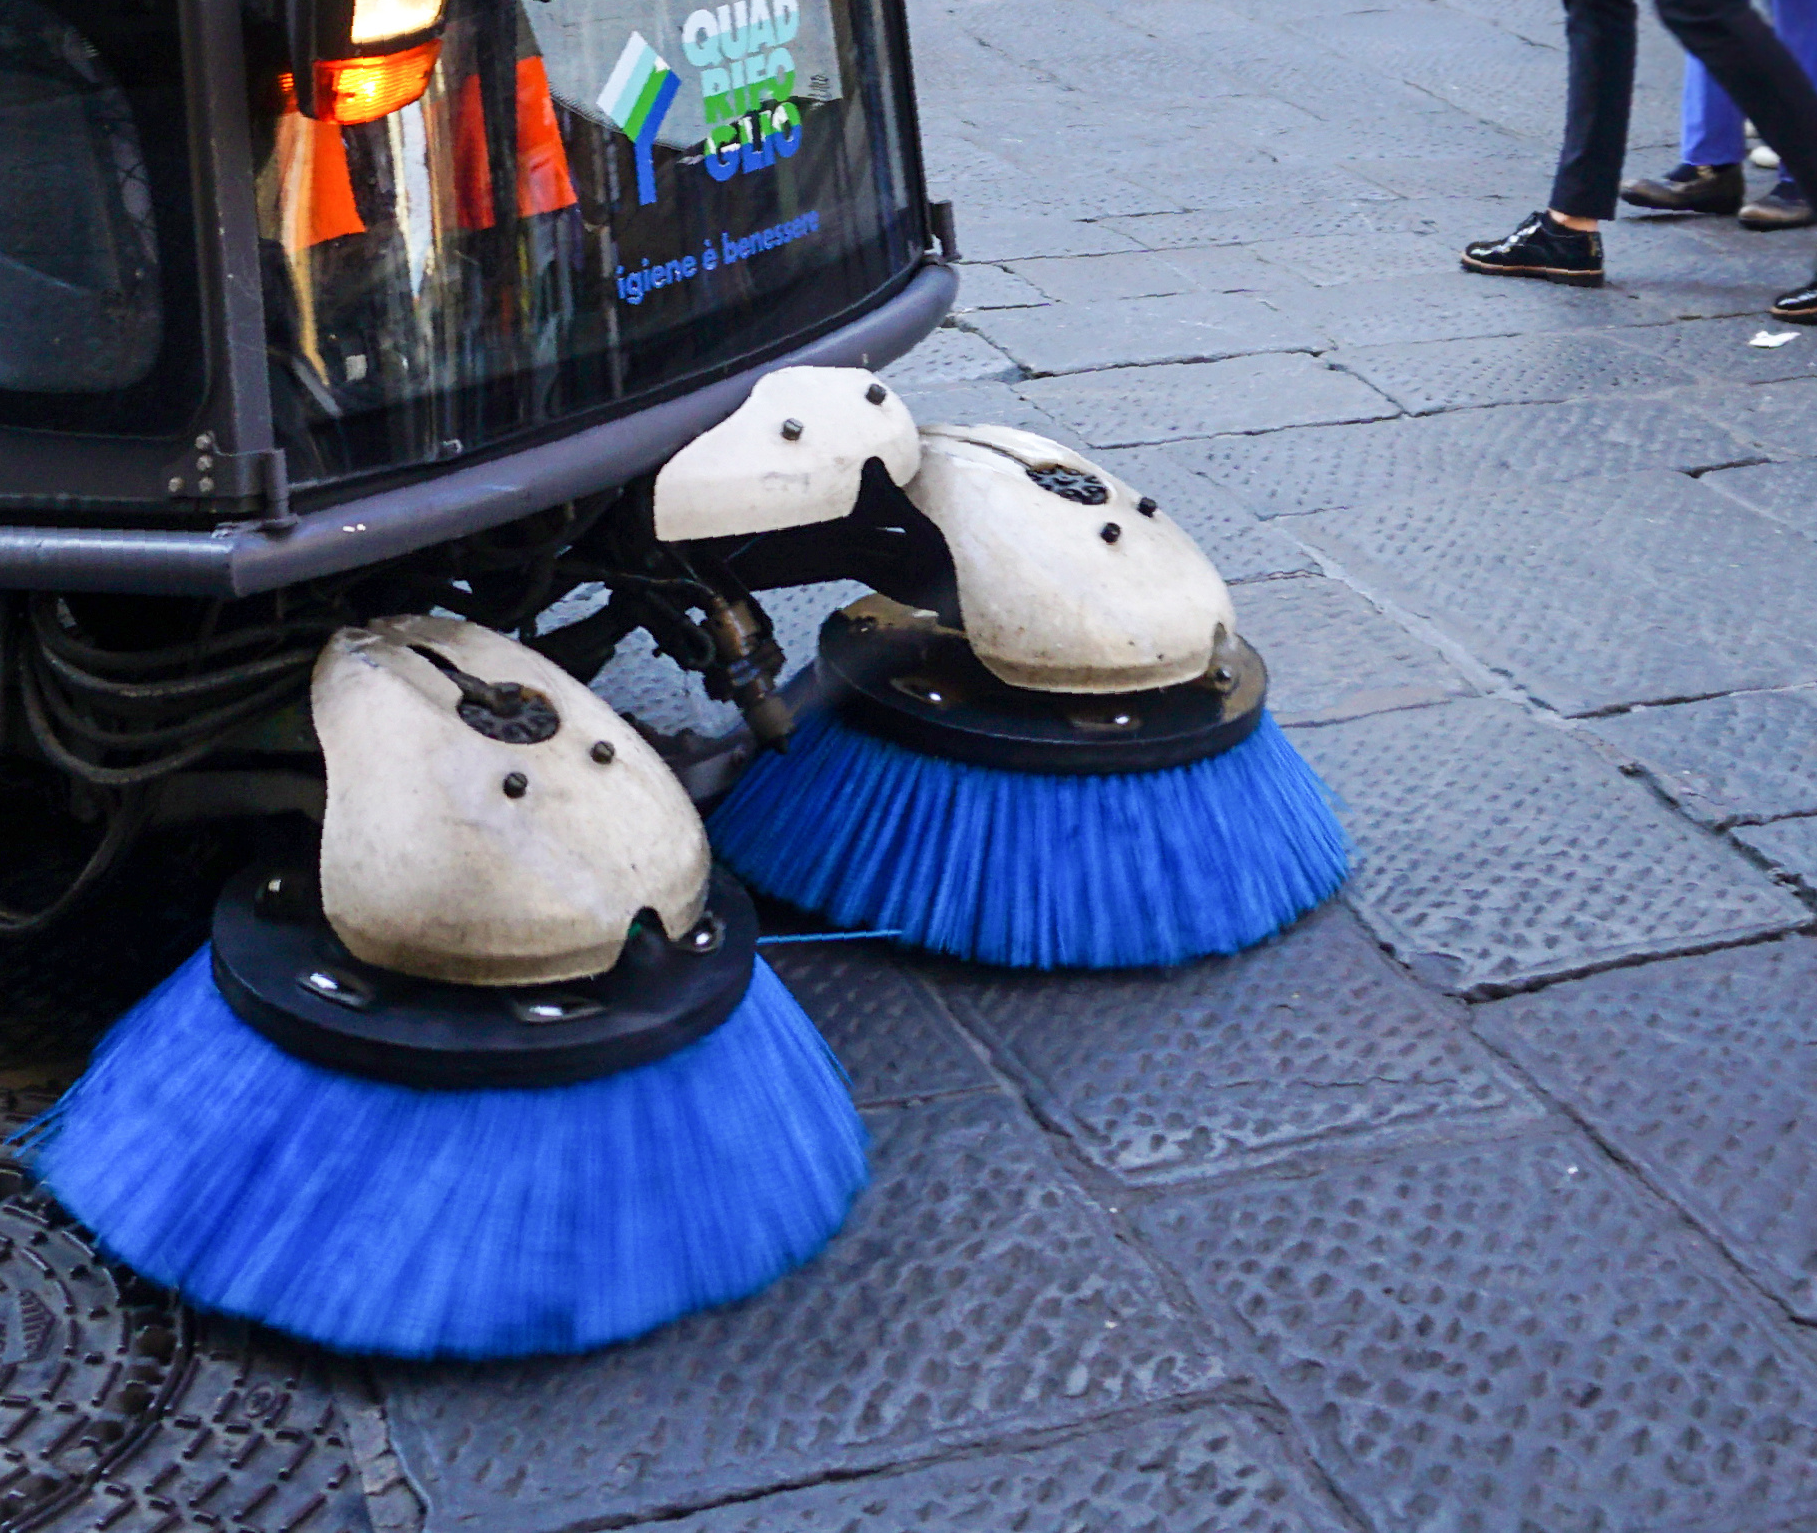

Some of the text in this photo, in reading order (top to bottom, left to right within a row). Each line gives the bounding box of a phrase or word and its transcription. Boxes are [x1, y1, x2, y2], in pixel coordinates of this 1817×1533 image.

[700, 48, 796, 124] RIFO
[704, 102, 802, 182] GLIO
[616, 210, 822, 305] igiene è benessere
